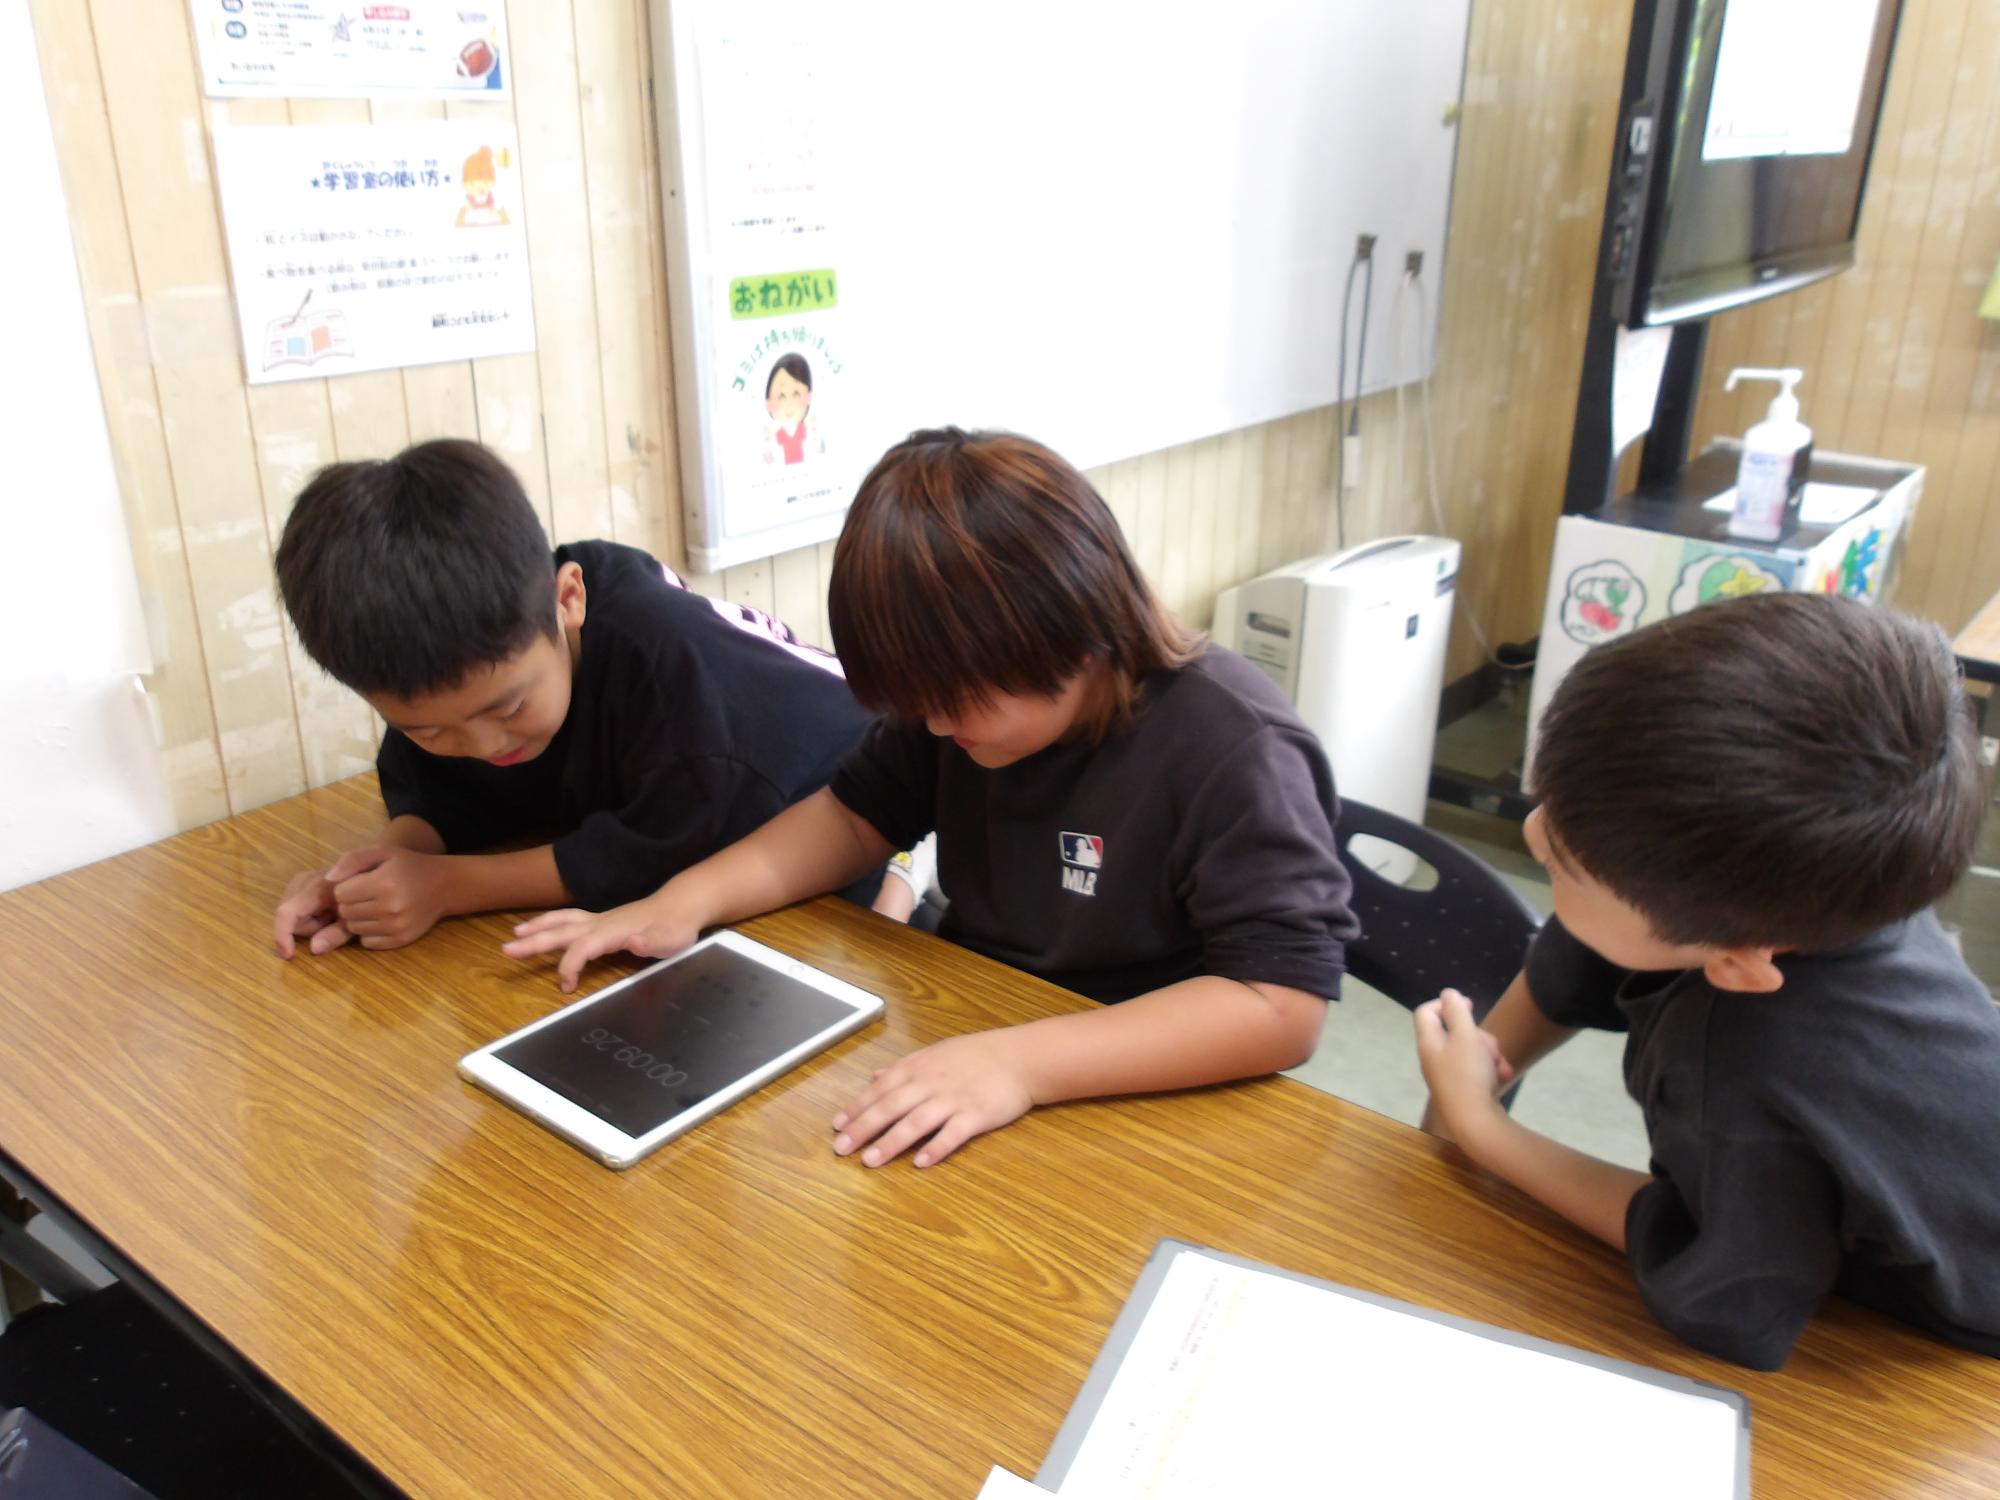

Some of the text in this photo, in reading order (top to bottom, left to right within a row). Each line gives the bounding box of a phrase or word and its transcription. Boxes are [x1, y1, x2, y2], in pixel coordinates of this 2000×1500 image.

[323, 169, 440, 192] 学習室の使い方
[734, 276, 836, 313] おねがい
[1062, 865, 1097, 896] MLB
[580, 1028, 689, 1087] 00:09.26
